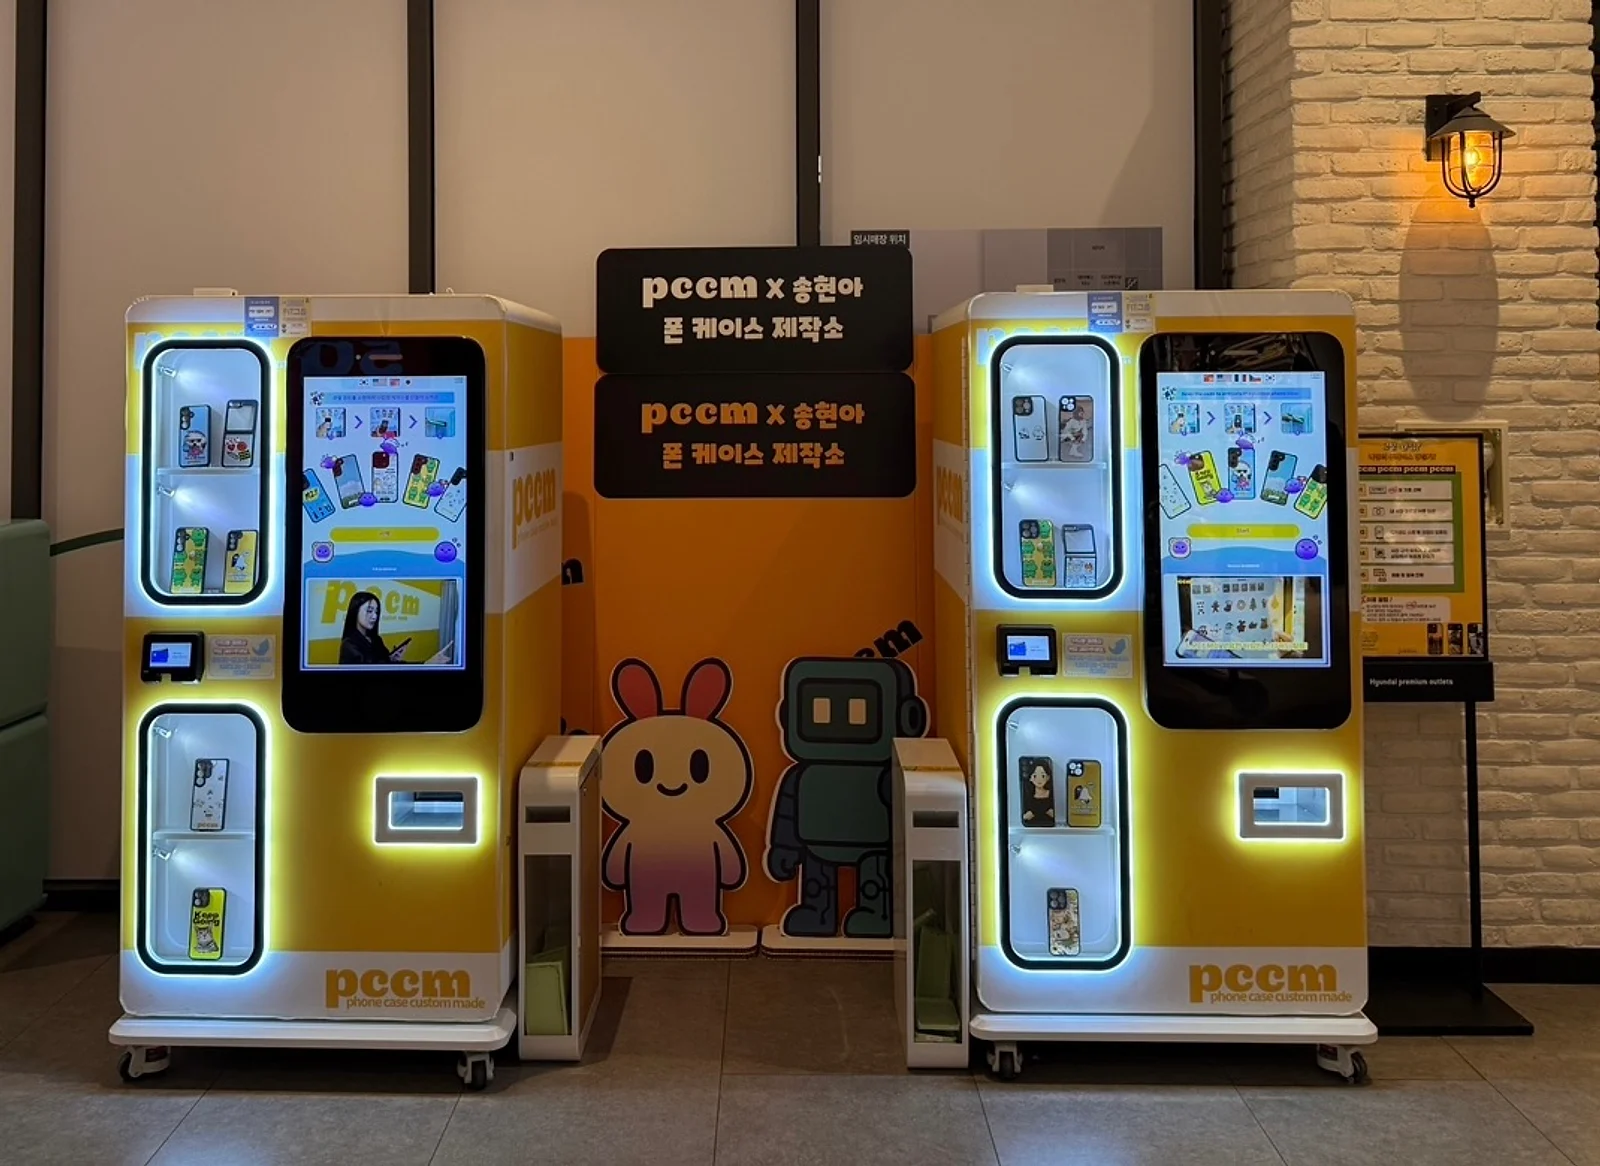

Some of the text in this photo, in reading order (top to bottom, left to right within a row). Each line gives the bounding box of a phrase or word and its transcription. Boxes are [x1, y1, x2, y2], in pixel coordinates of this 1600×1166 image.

[853, 233, 907, 246] 임시매장 위치
[642, 275, 758, 308] pccm
[792, 274, 864, 304] 송현아
[663, 316, 844, 344] 폰 케이스 제작소
[641, 402, 758, 434] pccm
[793, 401, 865, 430] 송현아
[662, 442, 845, 469] 폰 케이스 제작소
[512, 468, 556, 550] pccm
[1369, 677, 1454, 688] Hyundai premium outlets
[326, 968, 471, 1008] pccm
[1189, 964, 1338, 1003] pccm
[346, 996, 486, 1010] phone case custom made
[1210, 991, 1353, 1005] phone case custom made
